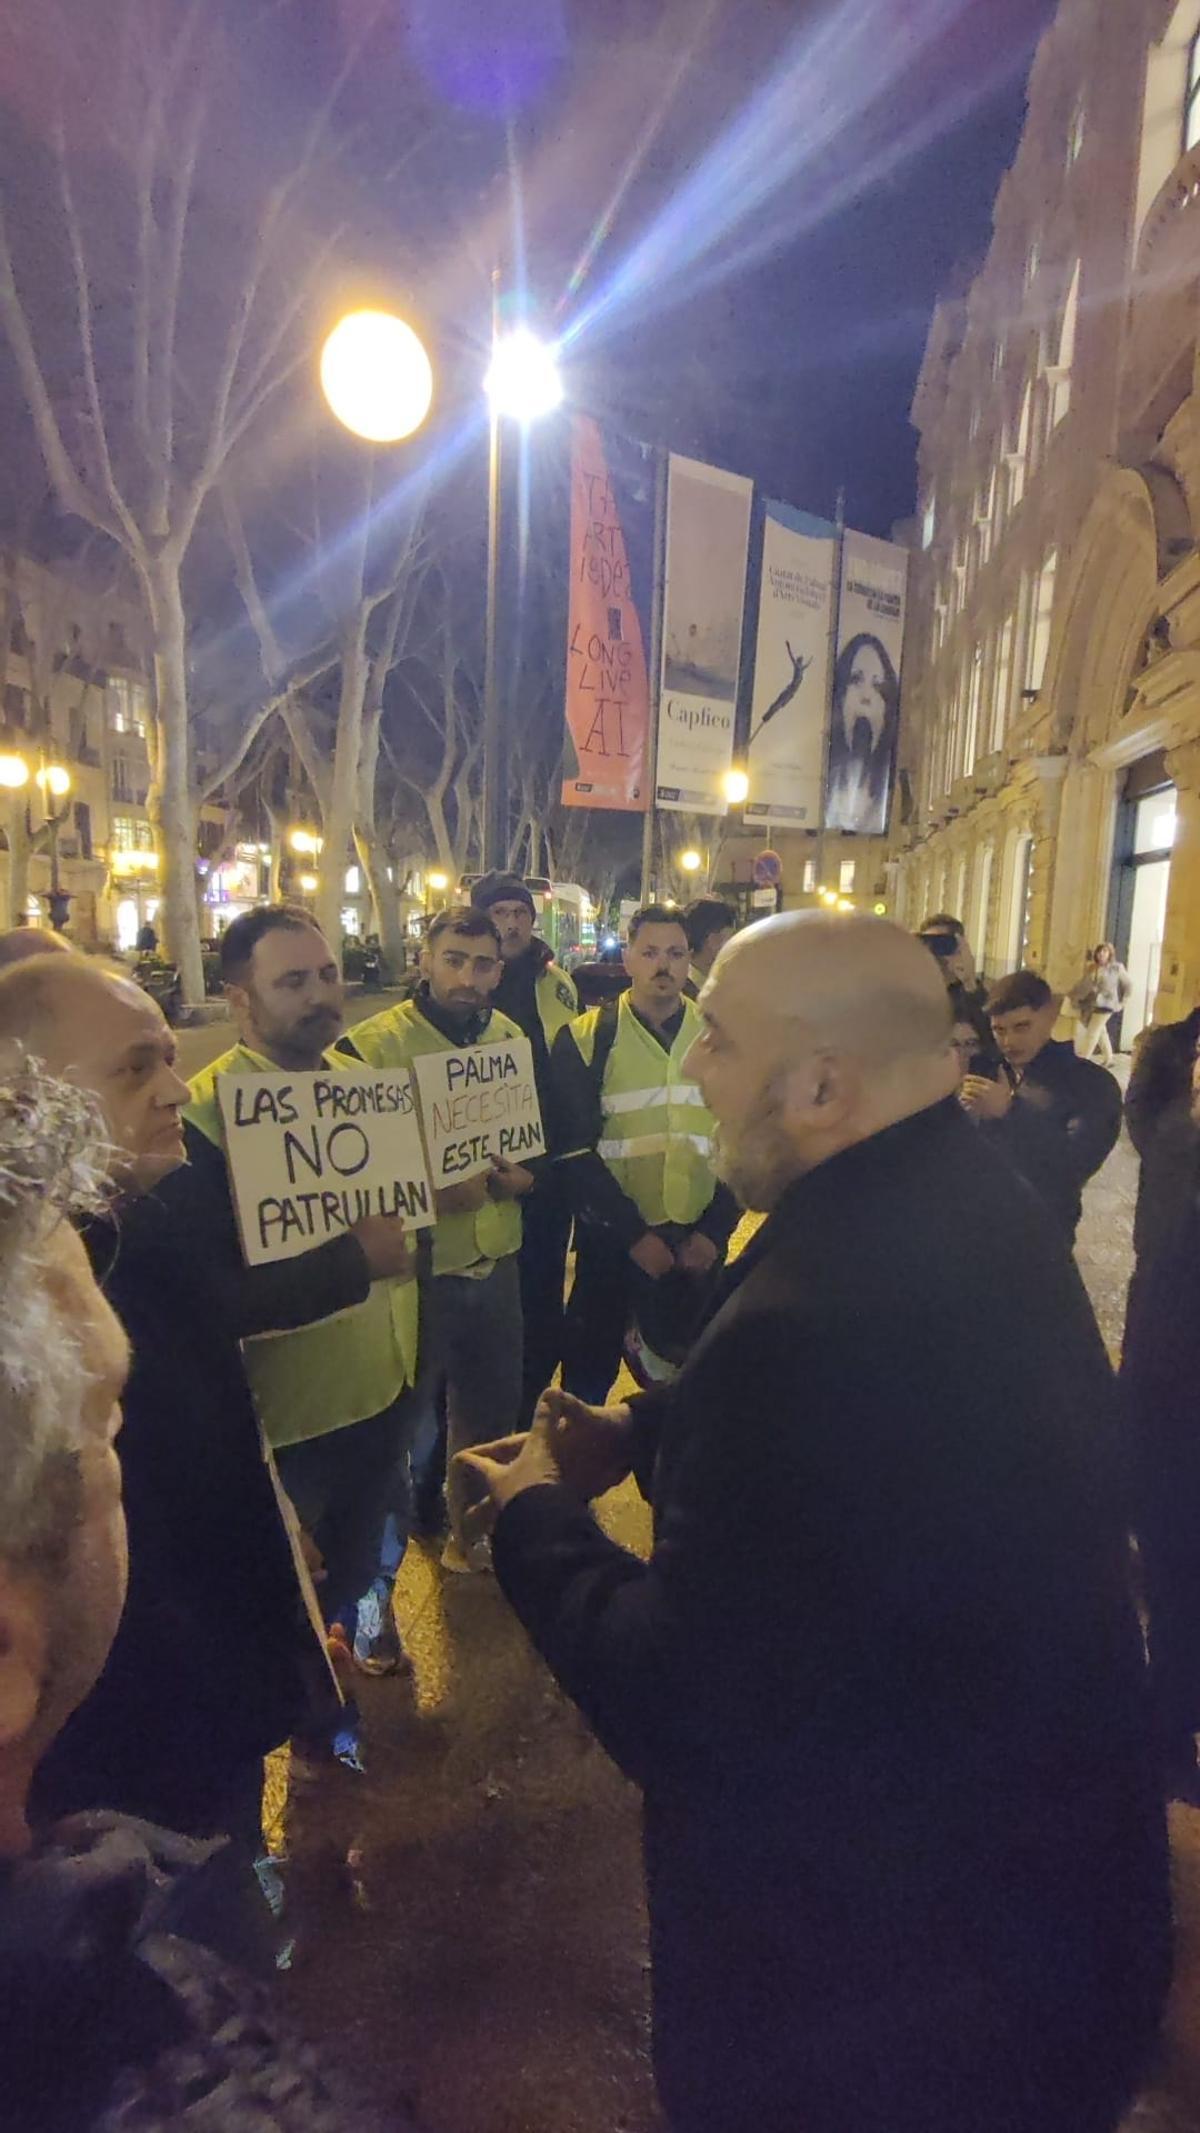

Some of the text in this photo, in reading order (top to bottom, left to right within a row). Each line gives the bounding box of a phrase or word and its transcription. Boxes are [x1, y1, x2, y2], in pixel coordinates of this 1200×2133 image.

[570, 624, 633, 667] LONG
[579, 698, 630, 757] AI
[446, 1050, 518, 1092] PALMA
[234, 1080, 415, 1127] LAS PROMESAS
[432, 1082, 533, 1139] NECESITA
[283, 1122, 370, 1184] NO
[442, 1121, 541, 1175] ESTE PLAN
